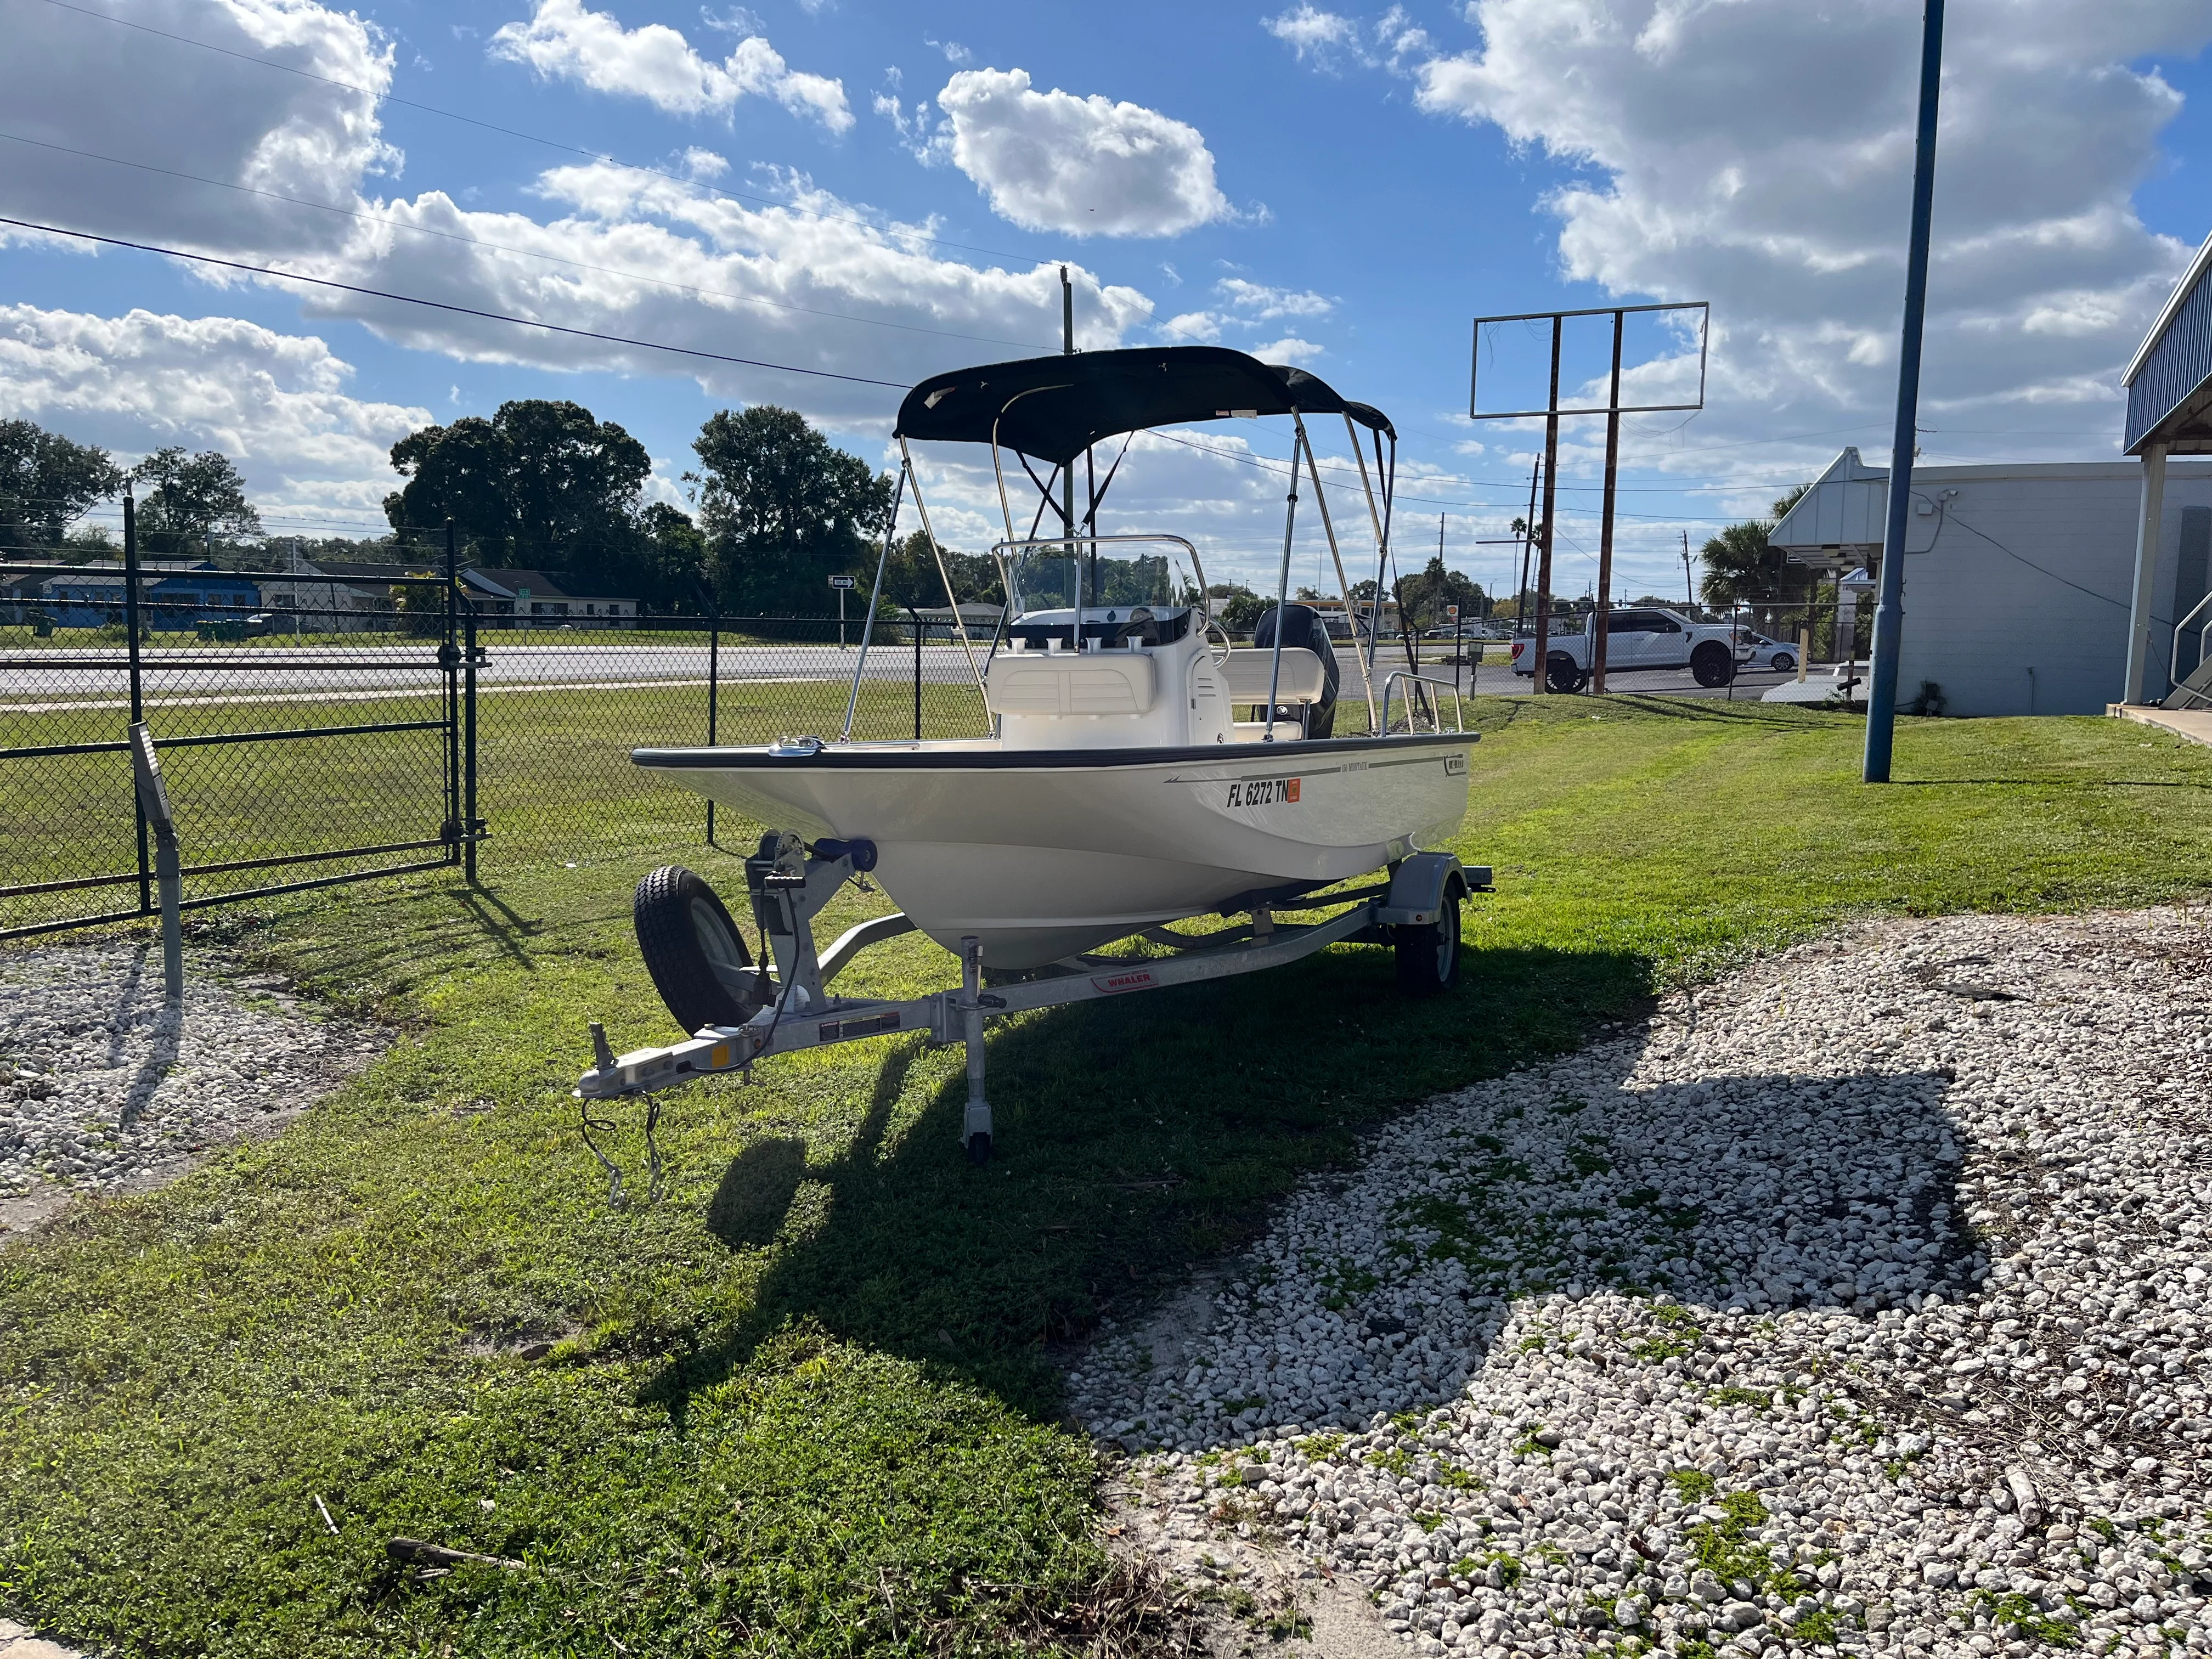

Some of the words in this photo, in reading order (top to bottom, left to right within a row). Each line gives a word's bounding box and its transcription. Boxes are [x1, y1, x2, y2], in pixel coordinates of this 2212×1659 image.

[1227, 784, 1242, 808] FL
[1245, 781, 1273, 806] 6272
[1276, 779, 1289, 803] TN
[1108, 974, 1151, 987] WHALER
